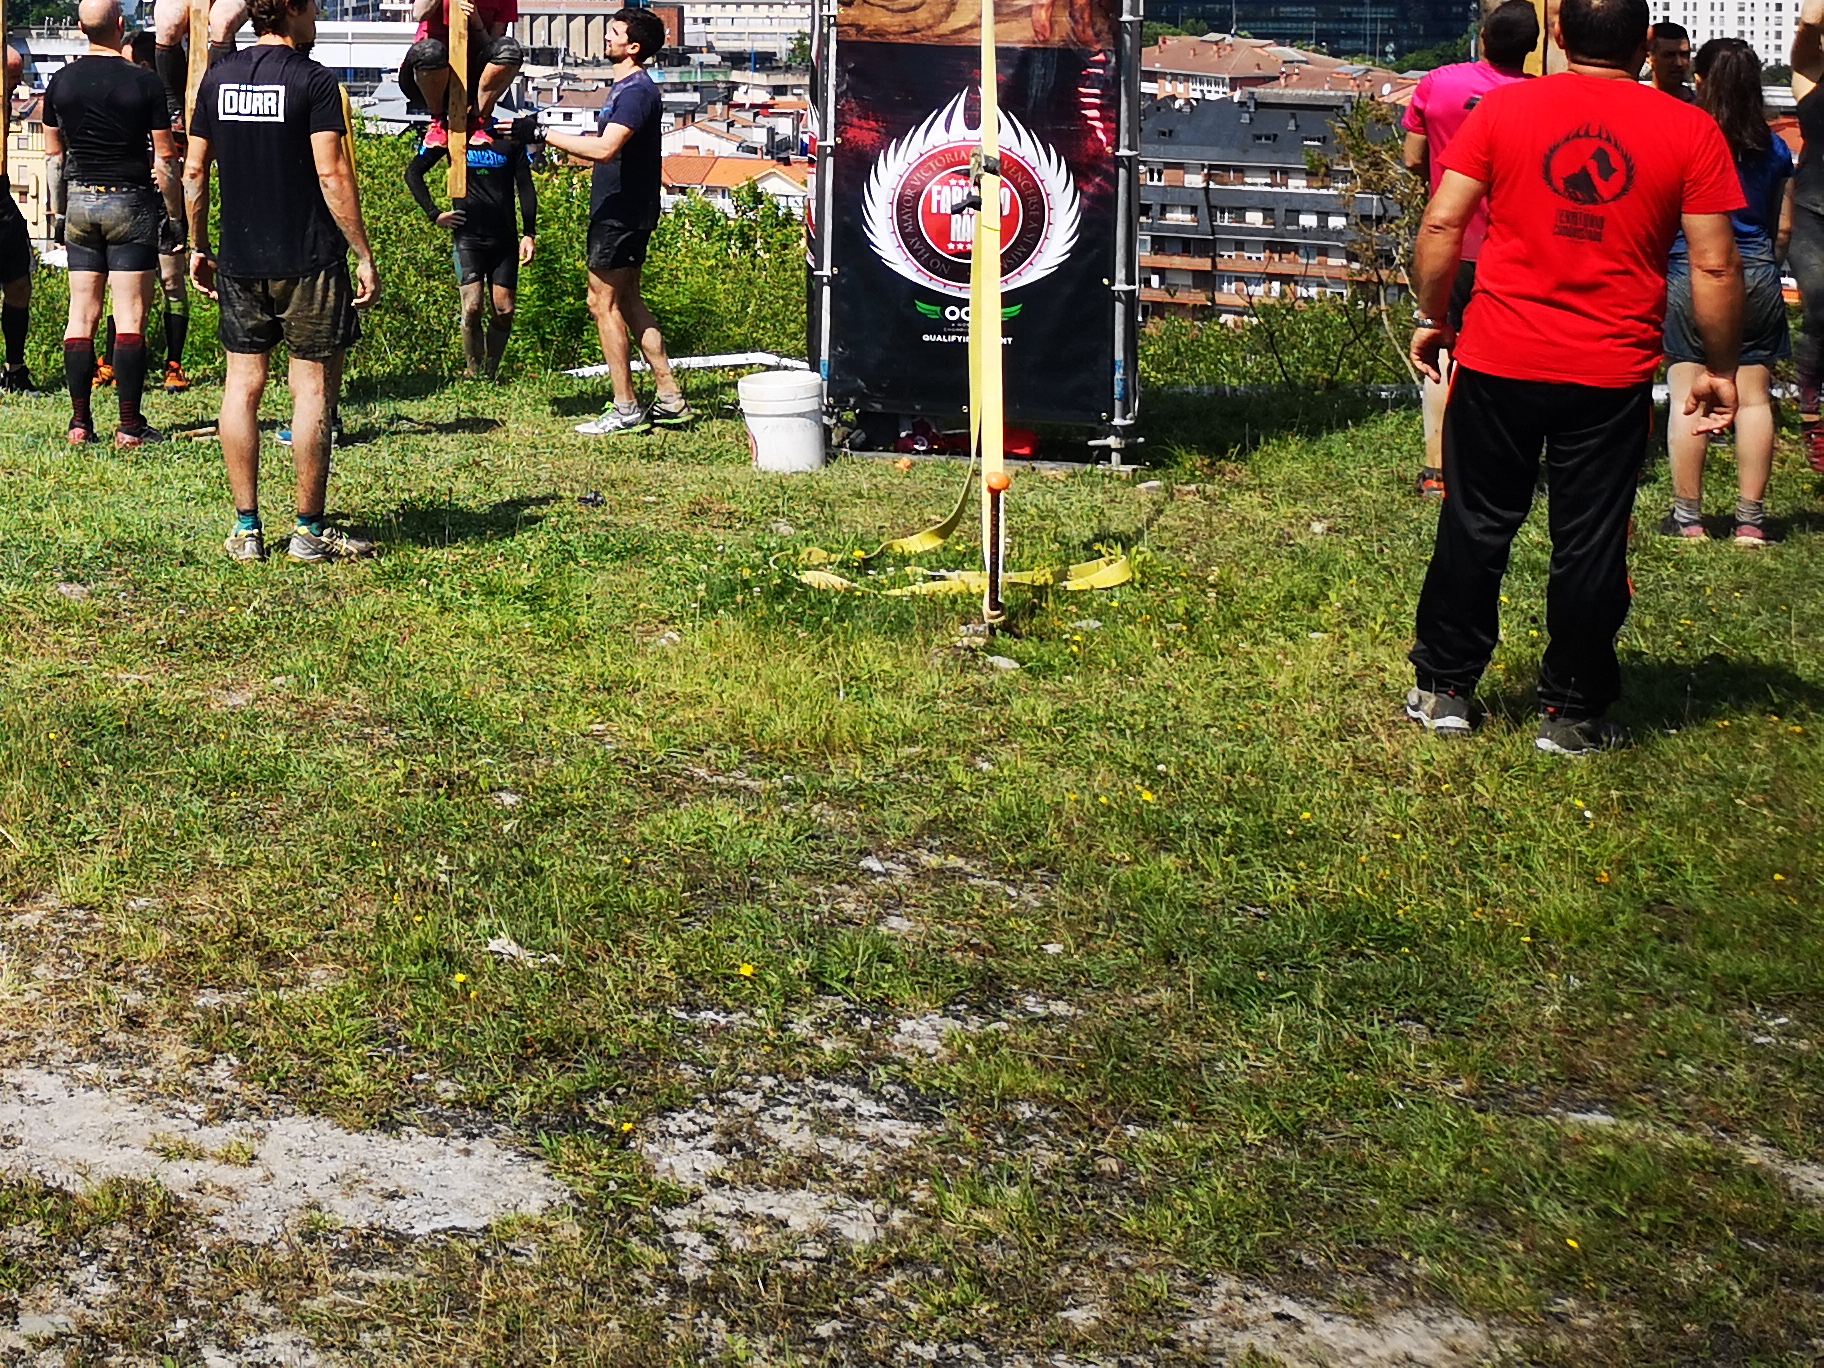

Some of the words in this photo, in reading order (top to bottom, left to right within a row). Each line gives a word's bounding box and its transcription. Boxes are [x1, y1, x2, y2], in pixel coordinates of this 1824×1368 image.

[225, 84, 277, 115] DÜRR
[910, 150, 968, 186] VICTORIA
[1002, 160, 1040, 216] VENCERSE
[900, 188, 916, 233] MAYOR
[951, 214, 975, 242] RA
[908, 237, 930, 260] HAY
[929, 258, 951, 274] NO
[944, 305, 970, 321] OC
[922, 334, 969, 343] QUALIFYI
